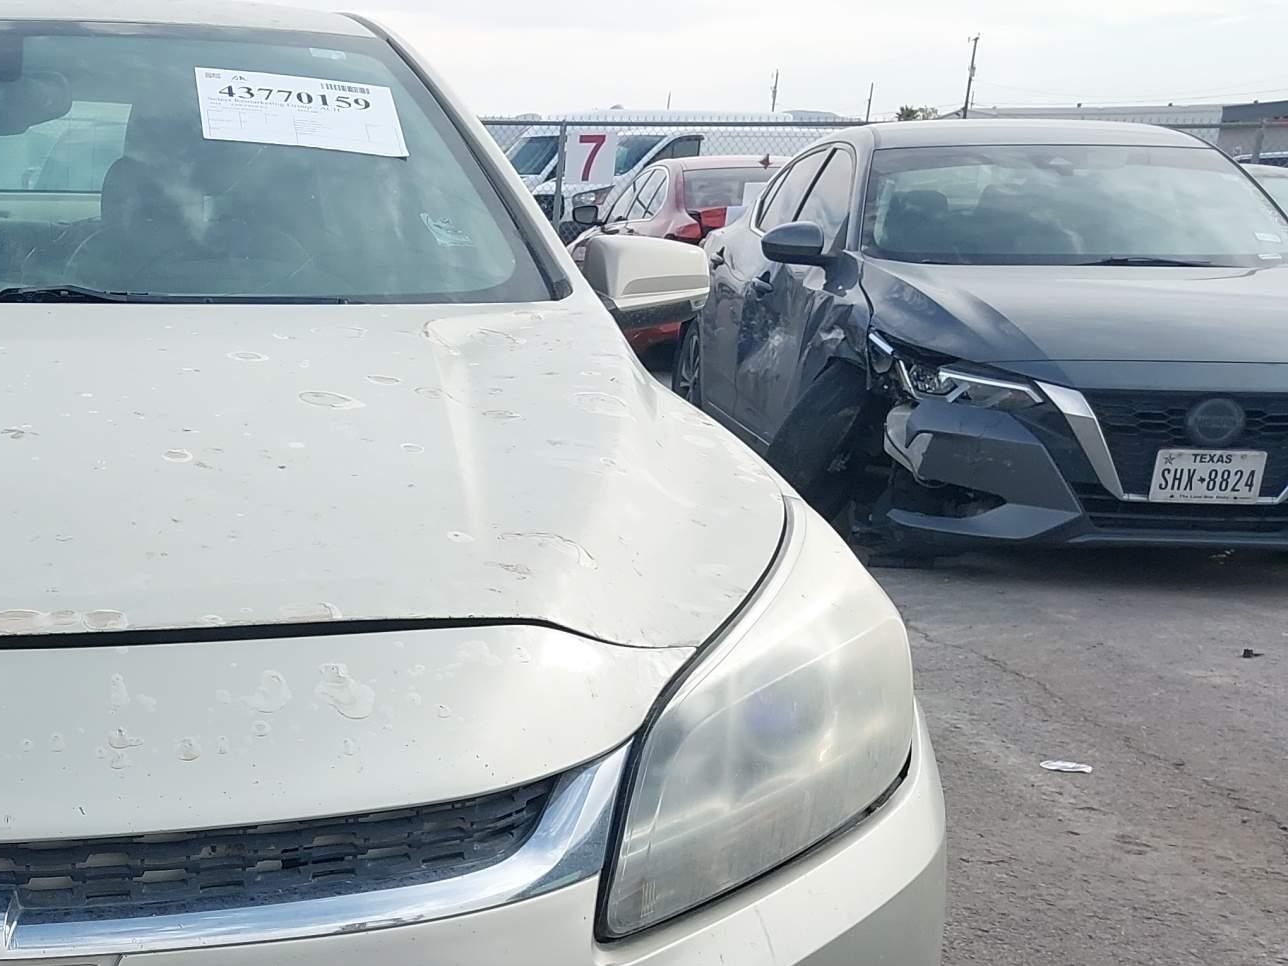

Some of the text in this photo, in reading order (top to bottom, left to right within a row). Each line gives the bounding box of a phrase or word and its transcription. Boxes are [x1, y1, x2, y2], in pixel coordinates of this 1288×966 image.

[218, 85, 371, 111] 43770159
[578, 134, 606, 181] 7
[1192, 453, 1233, 464] TEXAS
